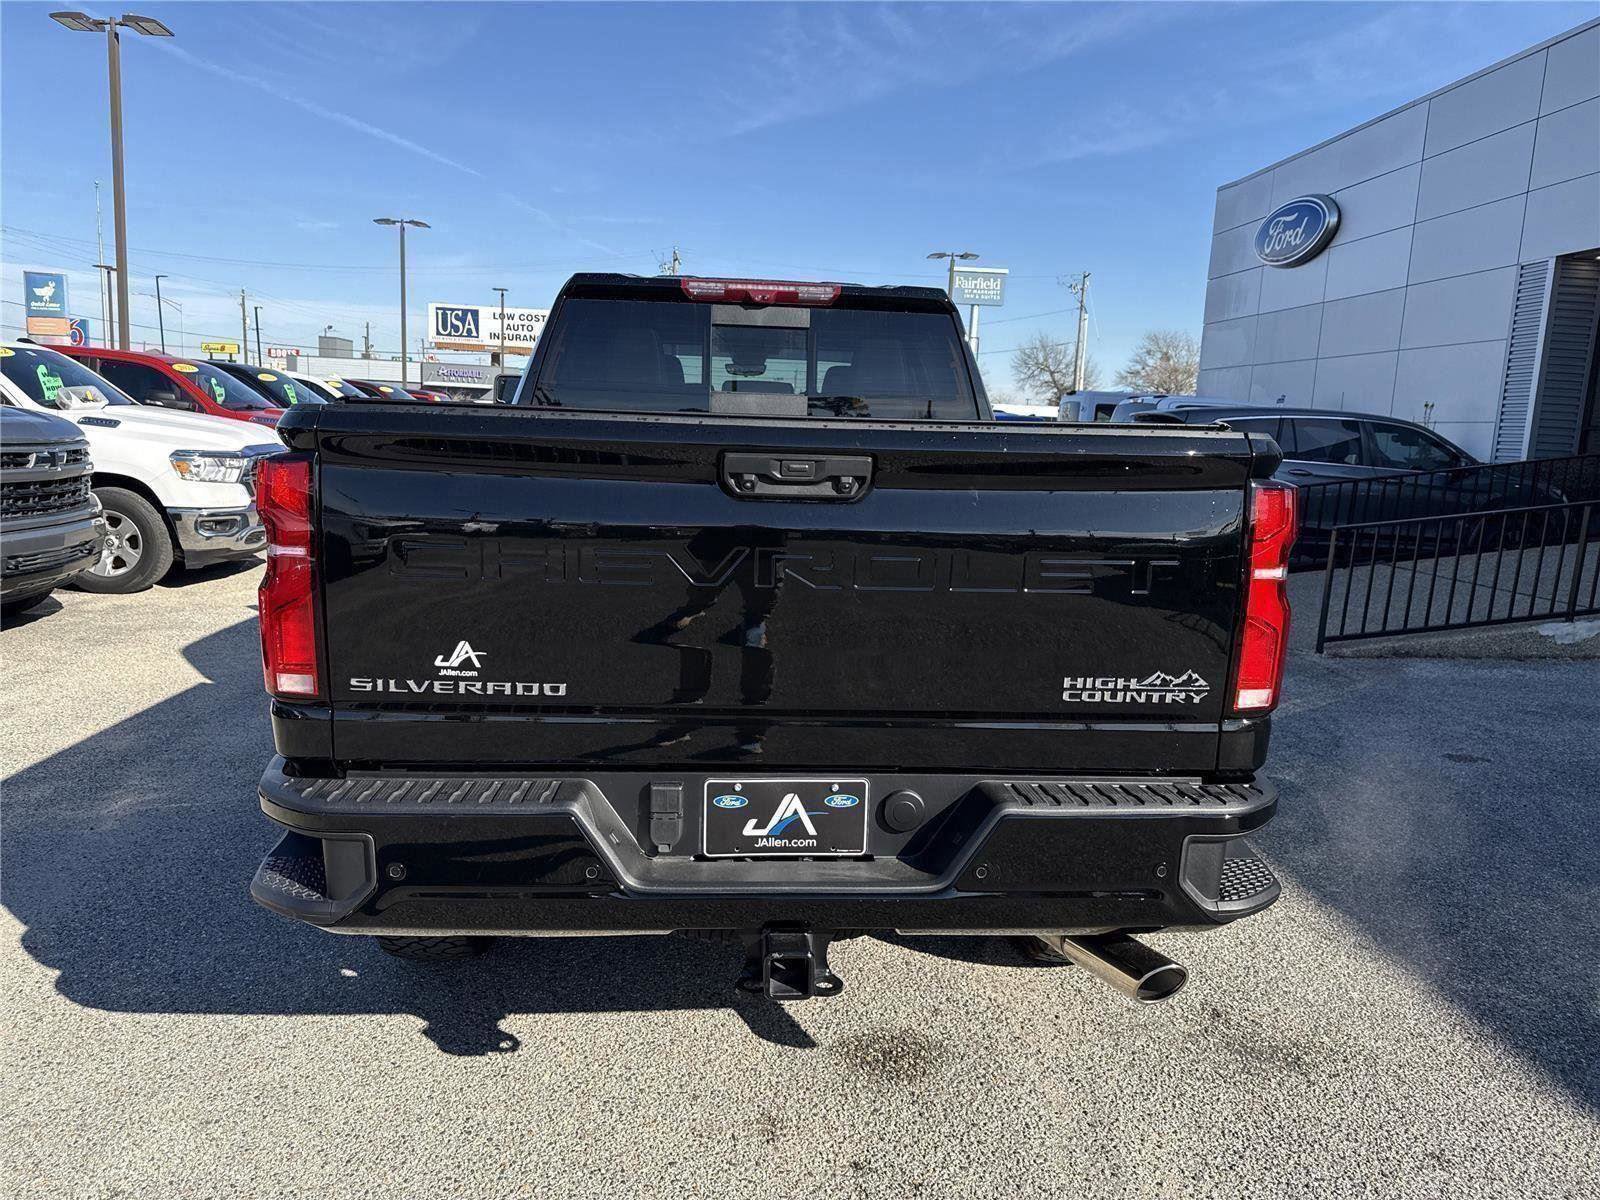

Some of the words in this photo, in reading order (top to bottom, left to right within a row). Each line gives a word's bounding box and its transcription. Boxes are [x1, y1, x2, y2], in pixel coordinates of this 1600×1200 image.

[1264, 212, 1309, 255] Ford
[954, 276, 1001, 290] Fairfield
[436, 309, 479, 337] USA
[493, 312, 515, 321] LOW
[518, 313, 547, 323] COST
[70, 319, 85, 346] 6
[506, 323, 534, 333] AUTO
[489, 332, 538, 342] INSURAN
[388, 537, 1182, 596] CHEVROLET
[438, 668, 479, 678] JAllen.com
[349, 677, 568, 697] SILVERADO
[1062, 675, 1139, 690] HIGH
[1061, 689, 1208, 705] COUNTRY
[719, 795, 742, 807] Ford
[830, 795, 853, 807] Ford
[754, 837, 817, 849] JAllen.com
